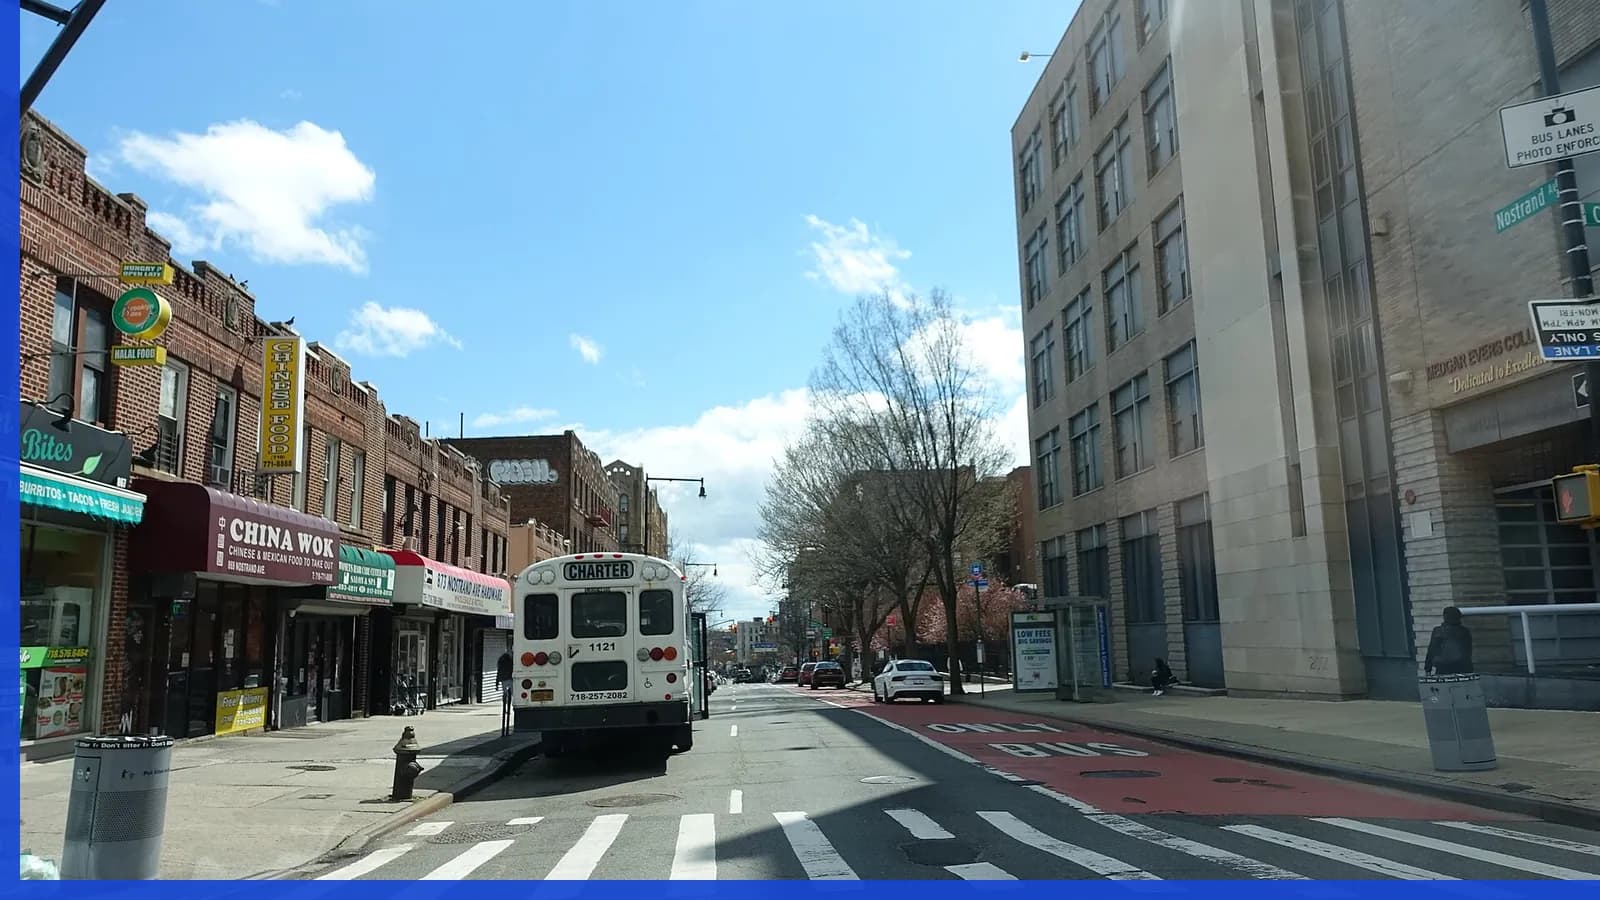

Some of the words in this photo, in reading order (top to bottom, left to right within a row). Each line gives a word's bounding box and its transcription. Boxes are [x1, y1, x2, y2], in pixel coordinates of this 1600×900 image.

[1531, 131, 1554, 145] BUS
[1558, 122, 1595, 140] LANES
[1516, 146, 1553, 161] PHOTO
[1496, 187, 1546, 231] Nostrand
[1550, 332, 1587, 343] ONLY
[114, 348, 136, 359] HALAL
[136, 348, 155, 359] FOOD
[1426, 352, 1468, 381] MEDGAR
[1468, 340, 1504, 367] EVERS
[1504, 327, 1537, 352] COLL
[1552, 346, 1592, 356] LANE
[269, 341, 294, 410] CHINESE
[268, 414, 291, 455] FOOD
[21, 428, 73, 462] Bites
[20, 480, 62, 500] BURRITOS
[67, 491, 94, 506] TACOS
[230, 518, 293, 551] CHINA
[298, 532, 334, 558] WOK
[228, 545, 255, 560] CHINESE
[256, 550, 261, 560] &
[262, 551, 288, 564] MEXICAN
[288, 555, 303, 566] FOOD
[304, 557, 311, 567] TO
[311, 558, 323, 569] TAKE
[324, 561, 334, 570] OUT
[235, 561, 256, 573] NOSTRAND
[568, 563, 629, 579] CHARTER
[447, 576, 472, 595] NOSTRAND
[1017, 630, 1033, 638] LOW
[588, 642, 616, 652] 1121
[570, 691, 628, 701] 718-257-2082
[927, 723, 1063, 733] ONLY
[987, 742, 1150, 758] BUS
